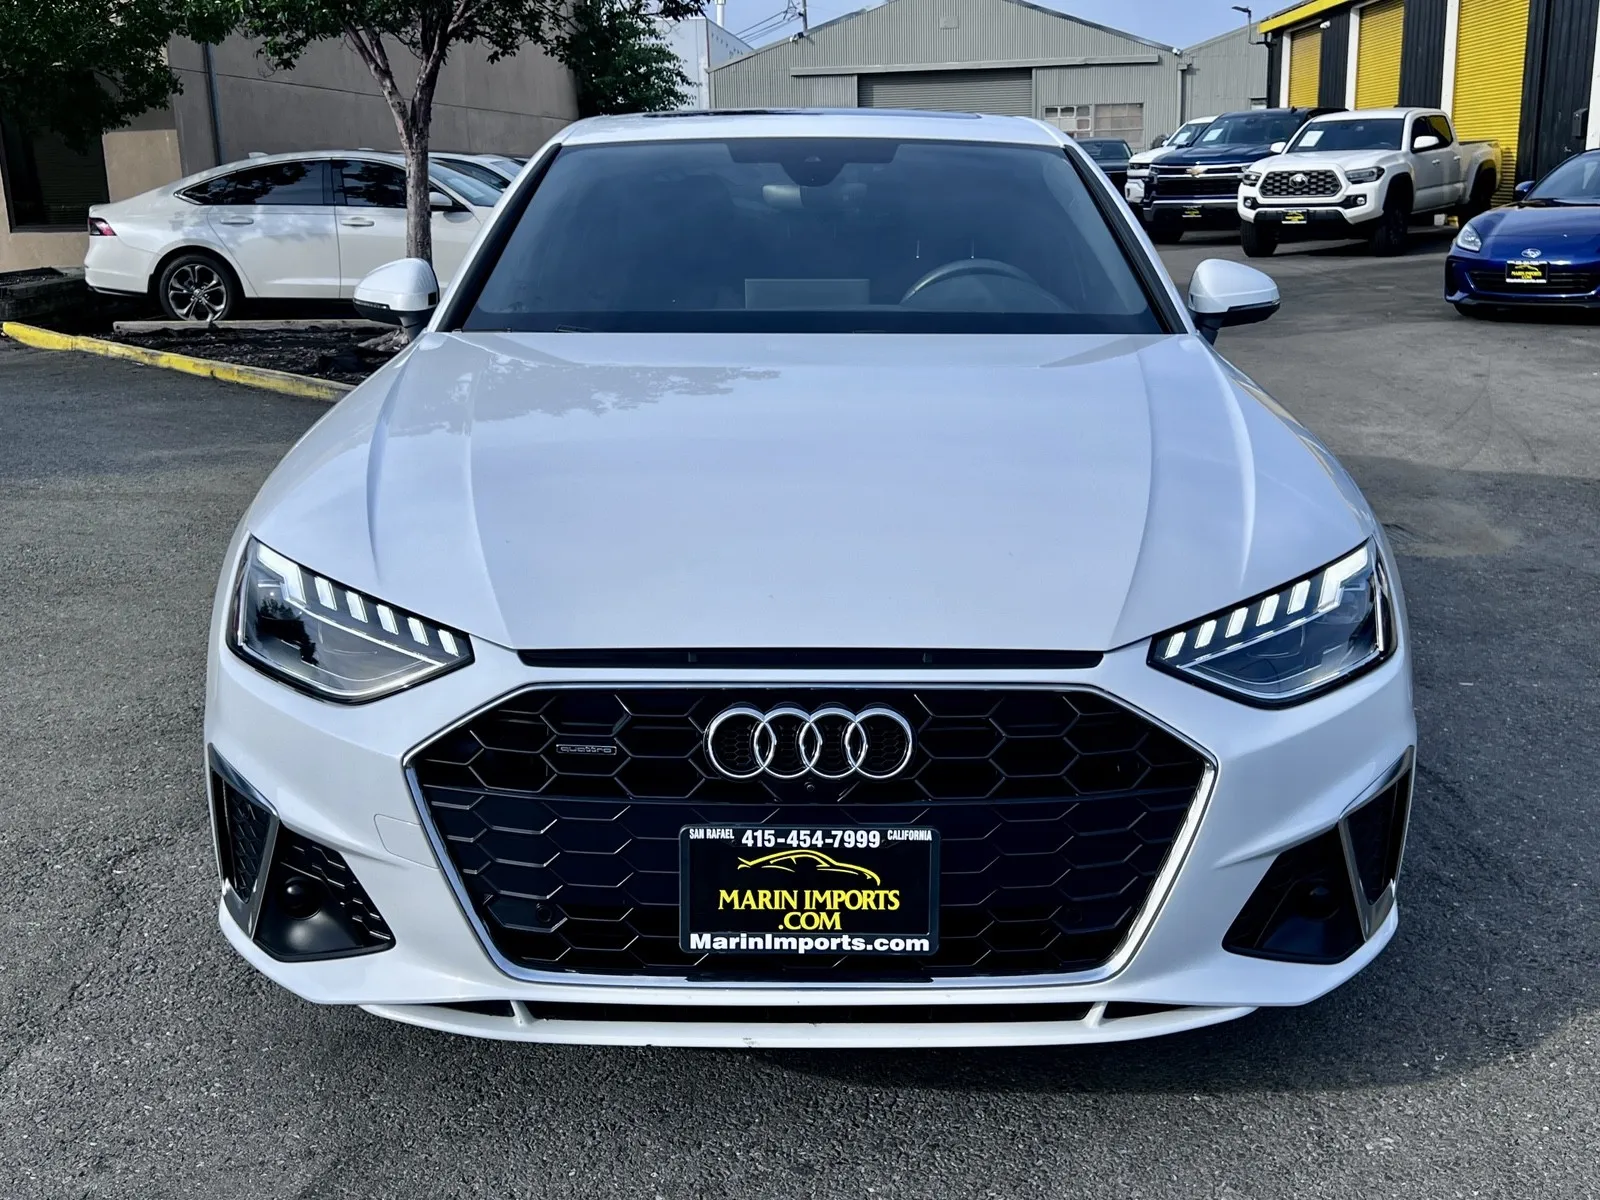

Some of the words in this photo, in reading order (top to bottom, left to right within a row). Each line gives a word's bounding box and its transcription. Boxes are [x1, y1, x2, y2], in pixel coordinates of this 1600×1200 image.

[689, 828, 705, 840] SAN
[706, 829, 735, 840] RAFAEL
[741, 830, 881, 848] 415-454-7999
[887, 829, 932, 841] CALIFORNIA
[718, 889, 798, 910] MARIN
[804, 889, 900, 910] IMPORTS
[778, 912, 842, 930] .COM
[689, 933, 930, 953] MarinImports.com
